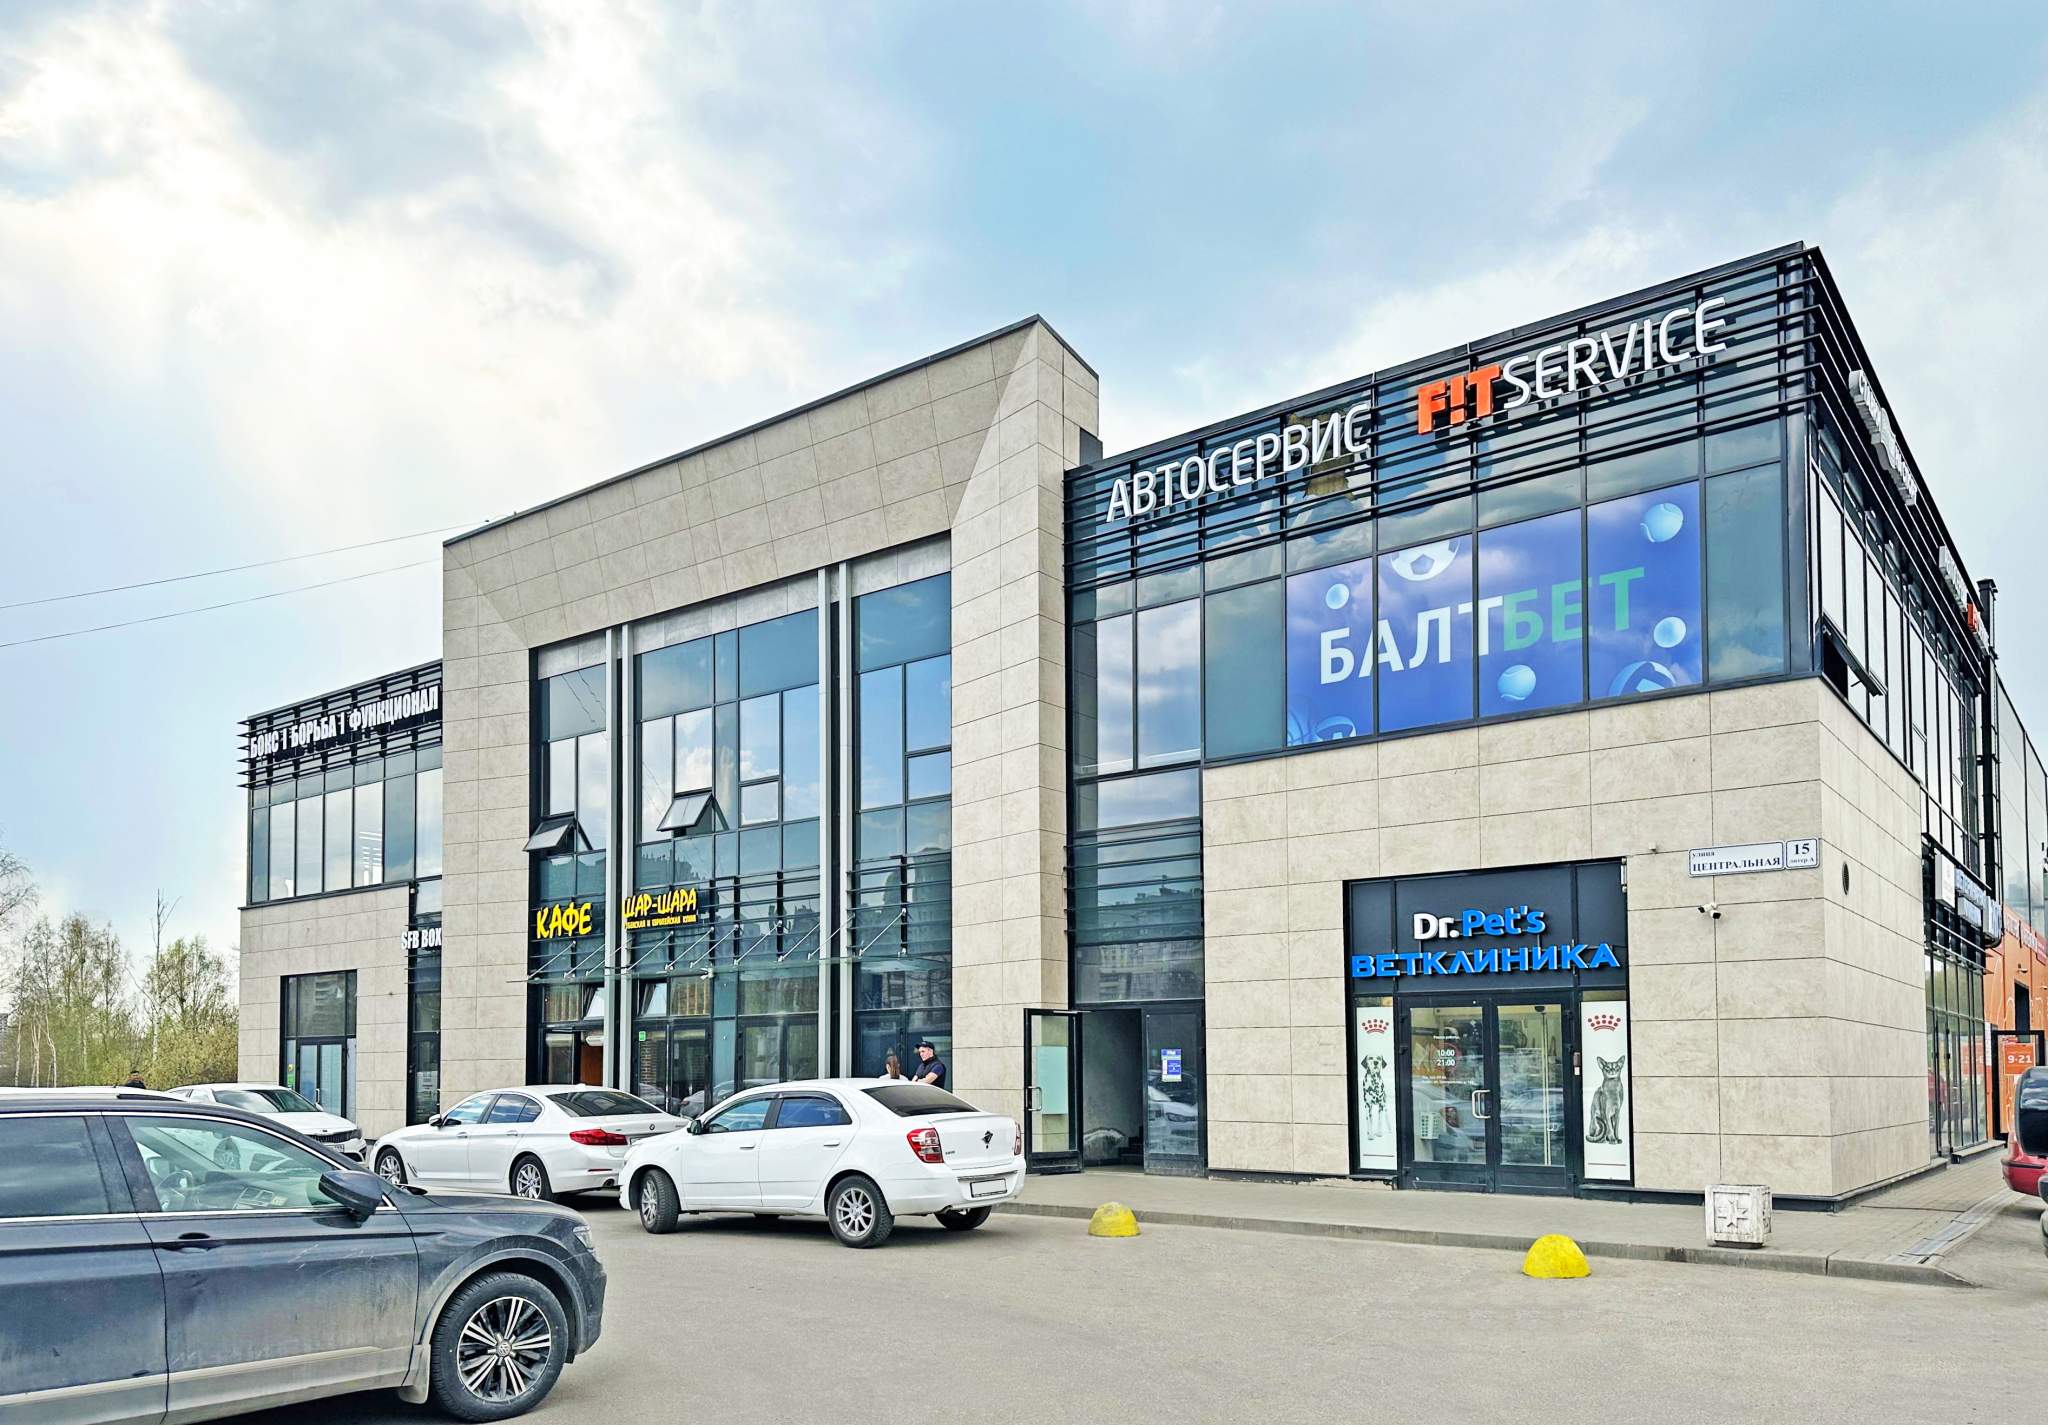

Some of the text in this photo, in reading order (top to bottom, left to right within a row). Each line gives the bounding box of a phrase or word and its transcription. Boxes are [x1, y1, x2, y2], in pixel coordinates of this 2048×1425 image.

[1106, 402, 1371, 523] АВТОСЕРВИС
[1320, 567, 1645, 685] БАЛТБЕТ
[250, 730, 279, 759] БОКС
[291, 715, 337, 747] БОРЬБА
[349, 685, 439, 732] ФУНКЦИОНАЛ
[1692, 857, 1781, 872] ЦЕНТРАЛЬНАЯ
[1794, 842, 1811, 855] 15
[536, 902, 592, 939] КАФЕ
[401, 928, 442, 950] SFB BOX
[1352, 943, 1621, 978] ВЕТКЛИНИКА
